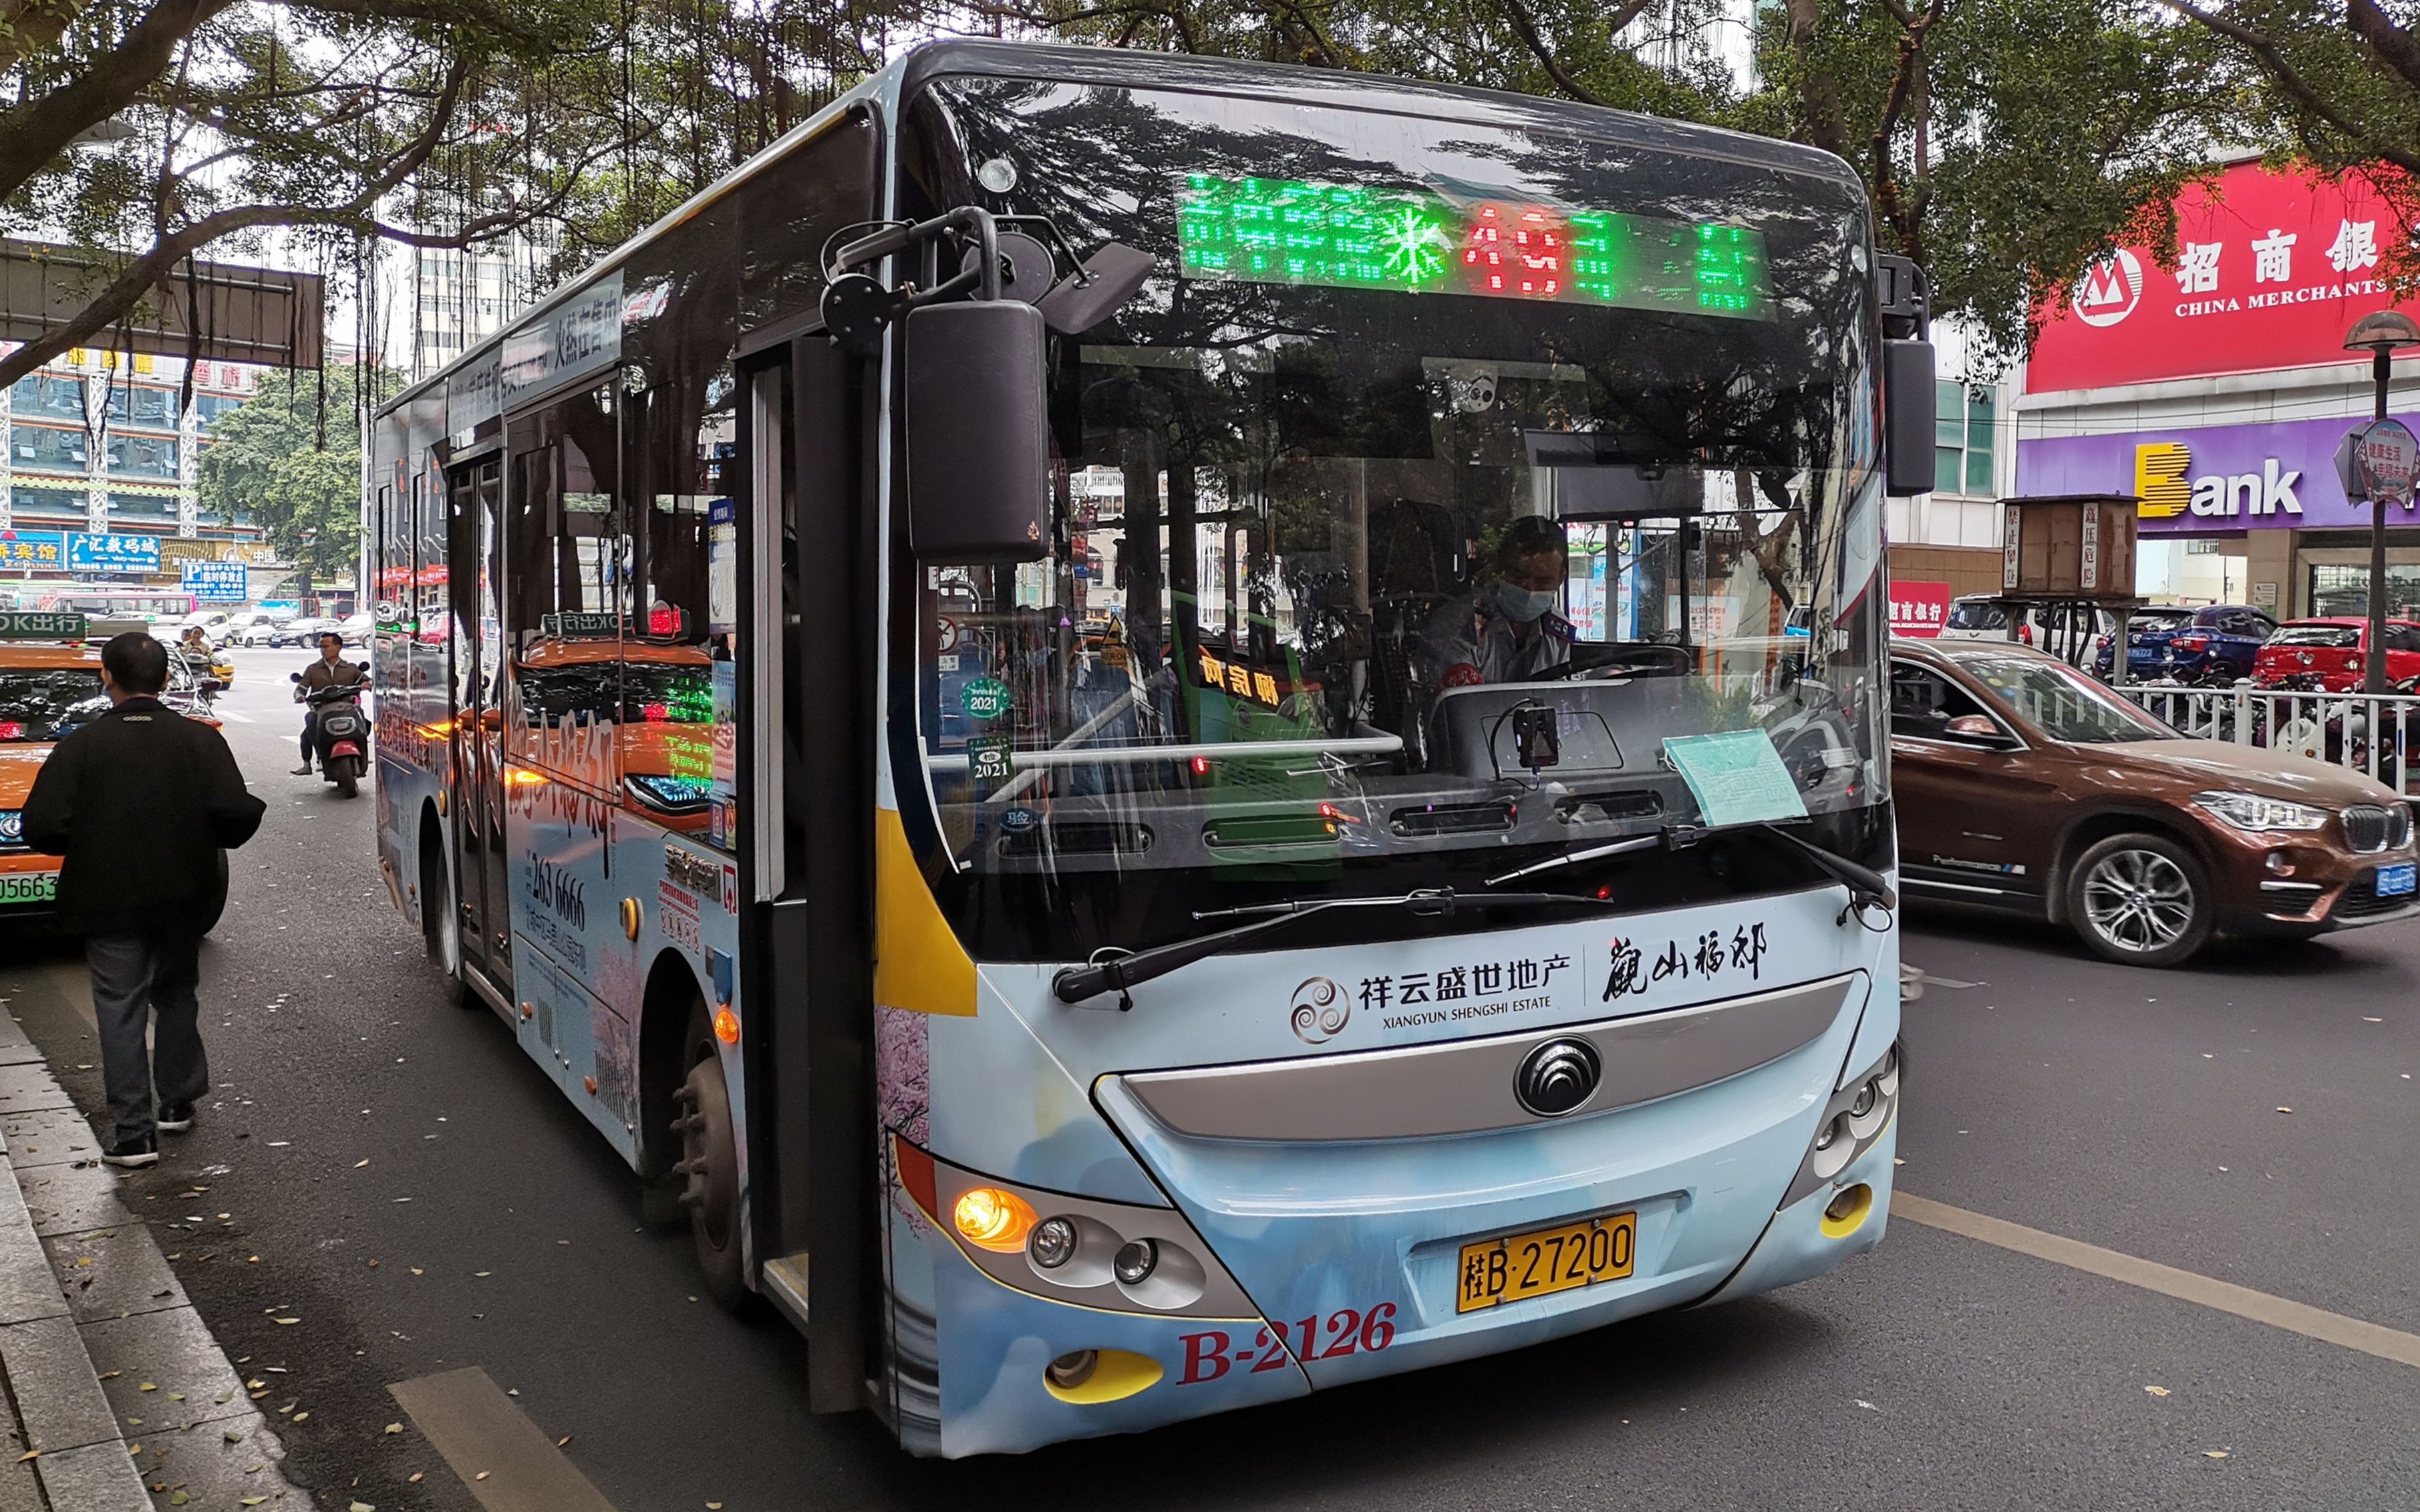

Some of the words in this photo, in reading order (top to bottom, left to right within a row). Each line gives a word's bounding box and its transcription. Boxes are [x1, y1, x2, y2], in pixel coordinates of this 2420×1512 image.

[2175, 218, 2420, 294] 招商銀
[2175, 297, 2241, 318] CHINA
[2248, 279, 2387, 309] MERCHANTS
[2369, 442, 2401, 462] 健康生活
[2135, 442, 2303, 518] Bank
[2377, 462, 2409, 480] 幸福未来
[71, 535, 159, 556] 广汇数码城
[253, 549, 277, 563] 中国
[2006, 509, 2018, 585] 禁止攀登
[2083, 507, 2097, 585] 高压危险
[186, 565, 201, 580] P
[970, 697, 997, 710] 2021
[973, 762, 1009, 778] 2021
[1007, 810, 1030, 825] 验
[532, 852, 552, 908] 263
[555, 868, 585, 932] 6666
[1358, 953, 1571, 1010] 祥云盛世地产
[1382, 1012, 1447, 1030] XIANGYUN
[1451, 1003, 1509, 1022] SHENGSHI
[1512, 996, 1551, 1012] ESTATE
[1175, 1302, 1398, 1386] B-2126
